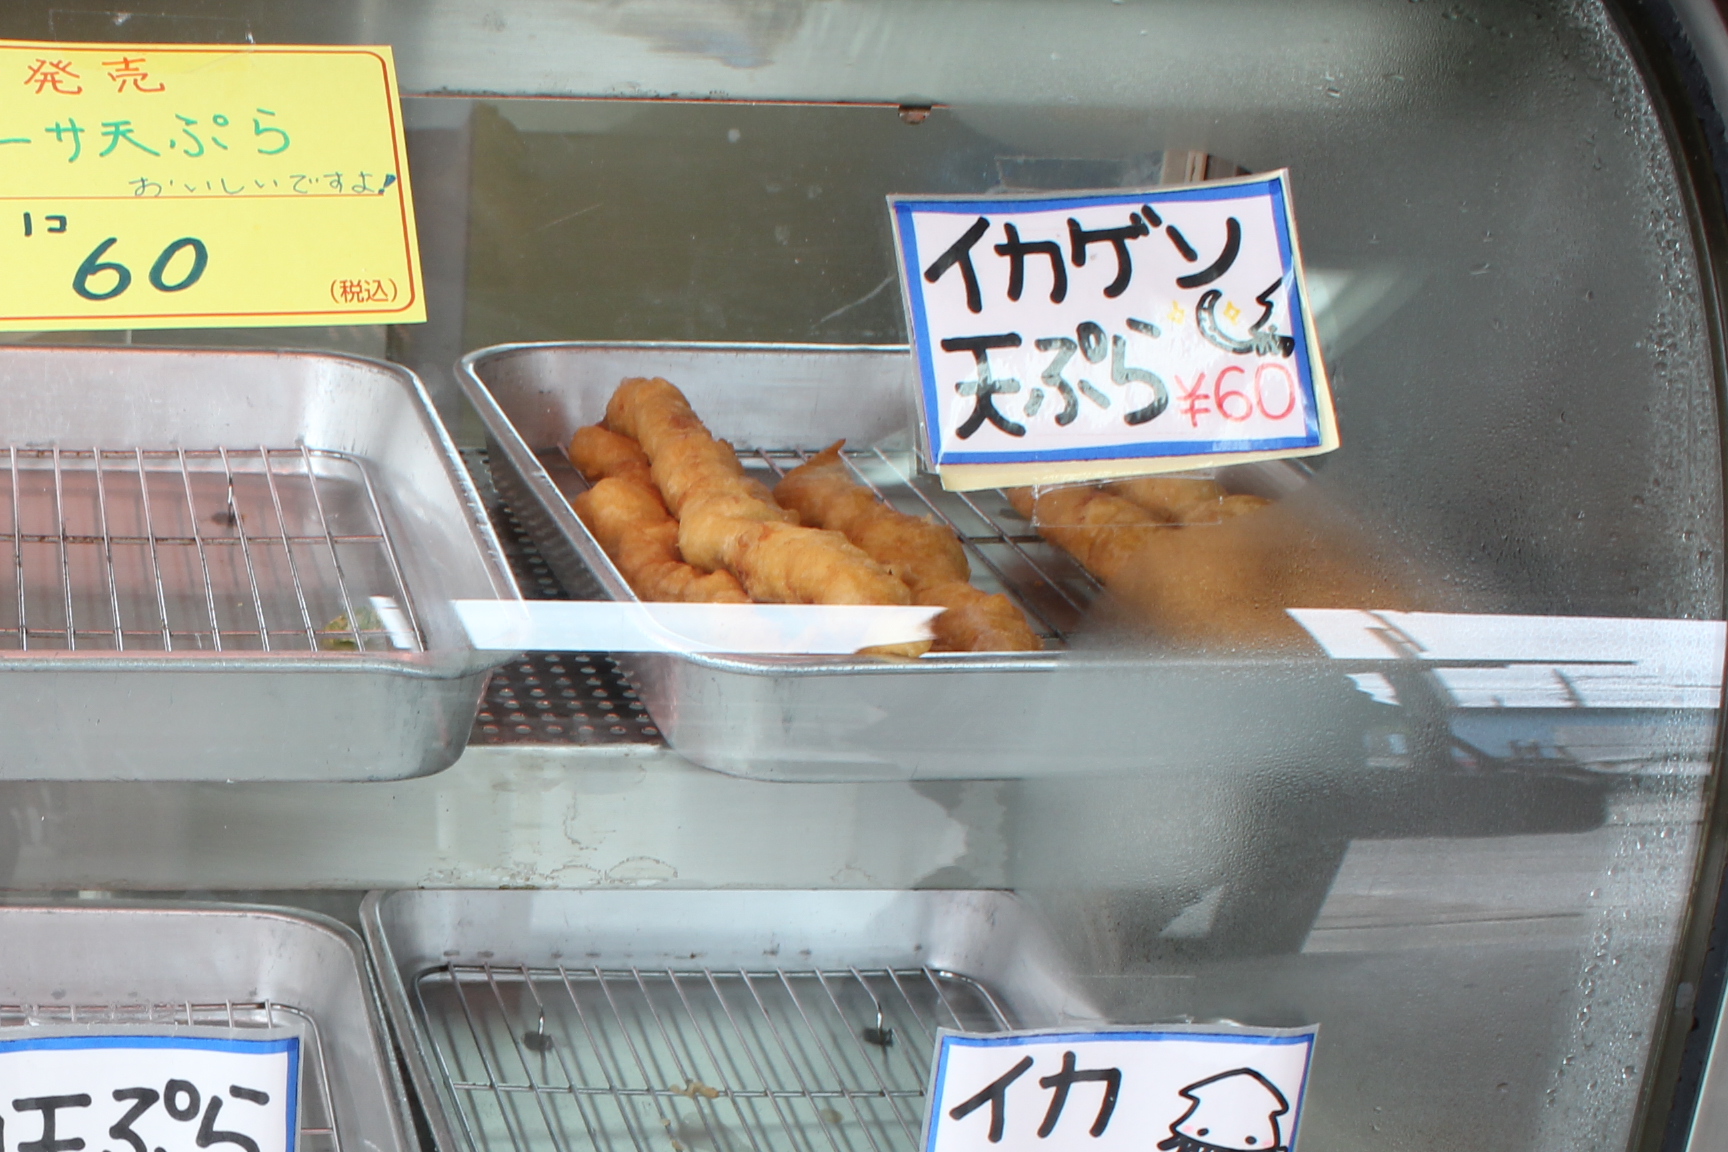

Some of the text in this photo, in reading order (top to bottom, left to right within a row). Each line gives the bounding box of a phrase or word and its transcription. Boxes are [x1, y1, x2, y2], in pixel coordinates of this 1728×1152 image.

[72, 236, 209, 300] 60
[924, 205, 1242, 313] イカゲソ
[941, 319, 1295, 440] 天ぷら ¥60
[949, 1050, 1122, 1143] イカ
